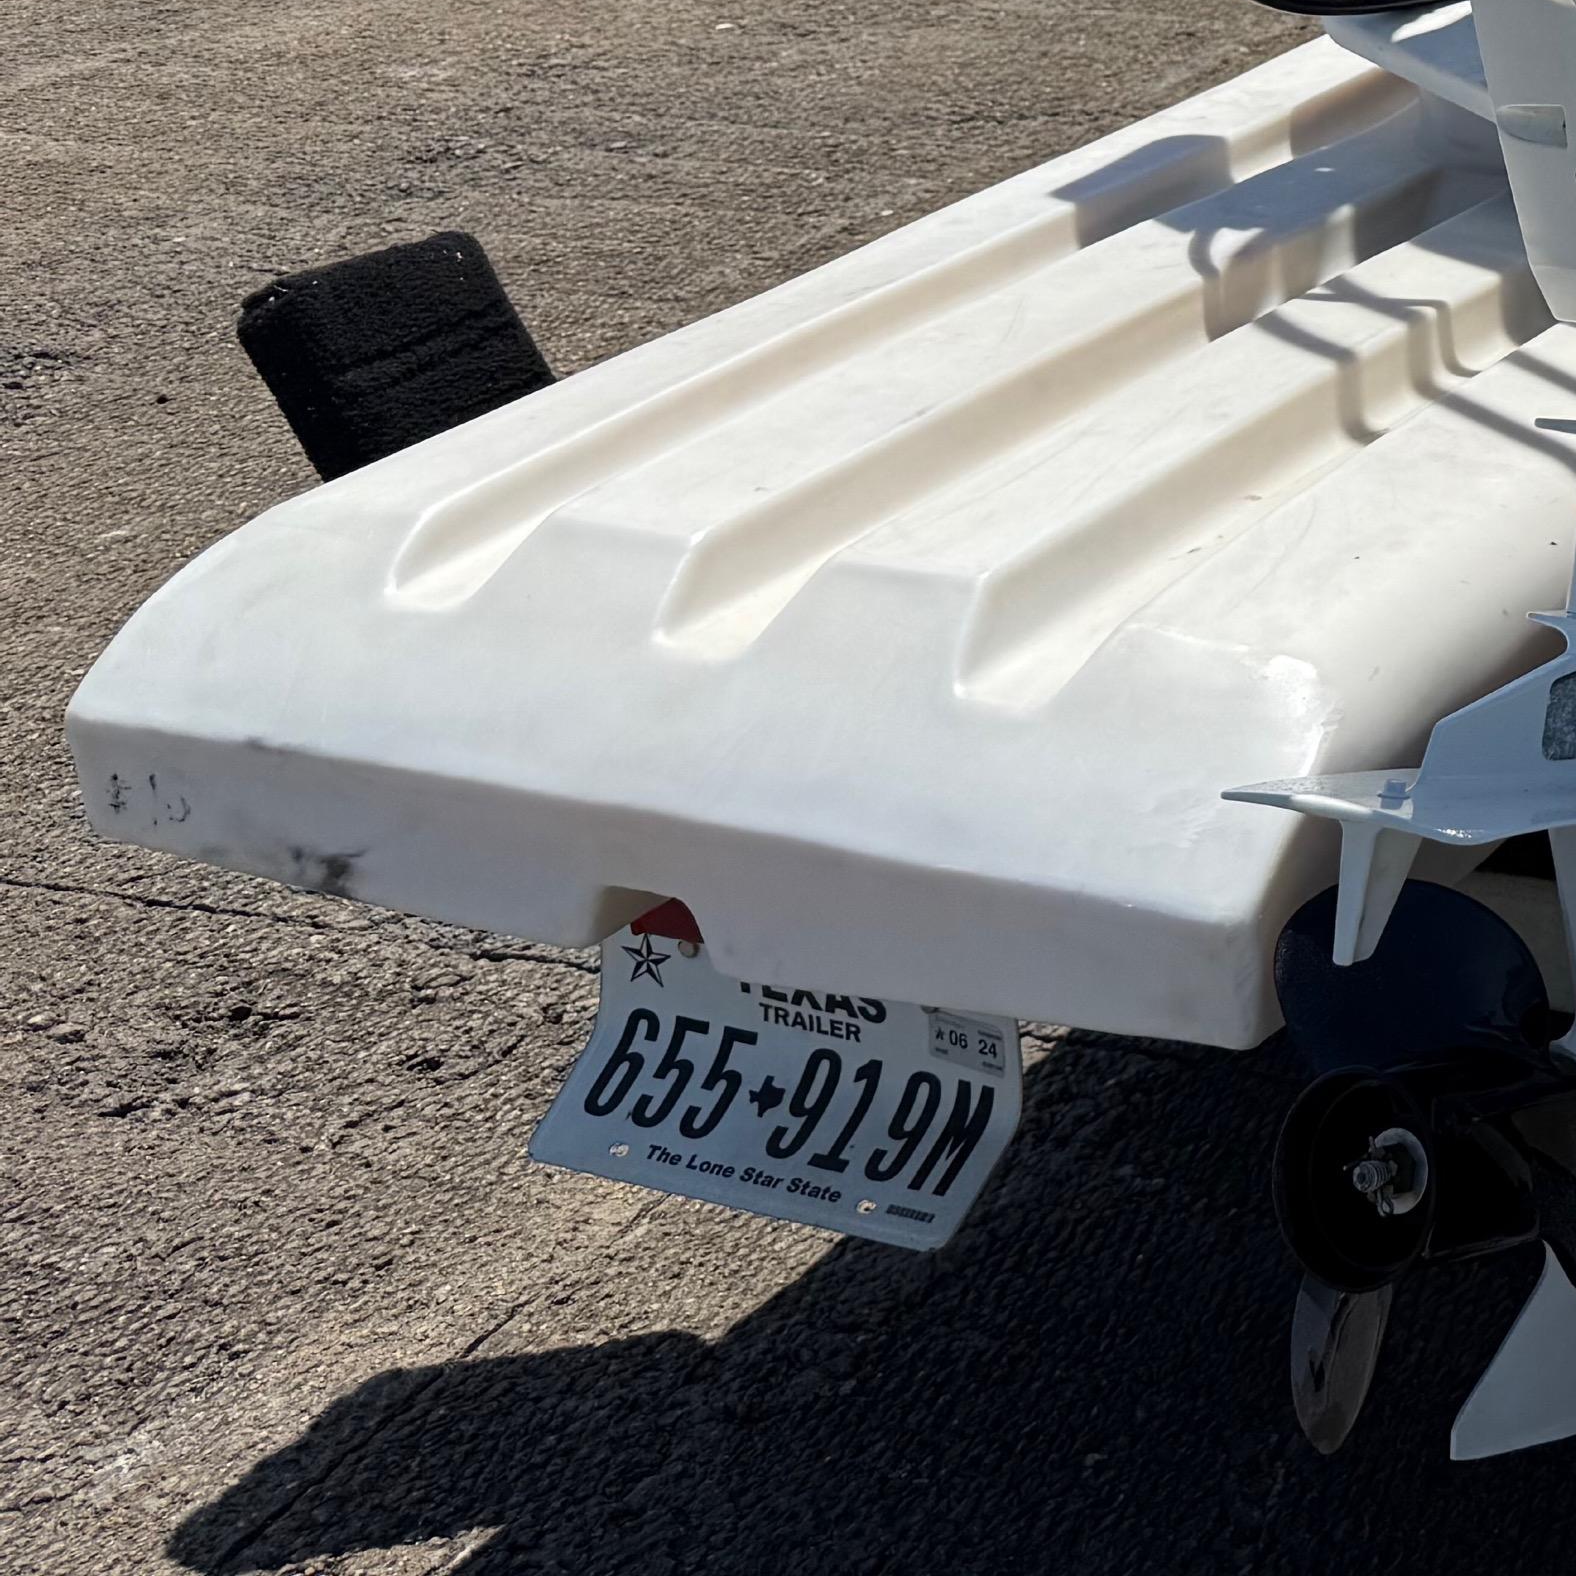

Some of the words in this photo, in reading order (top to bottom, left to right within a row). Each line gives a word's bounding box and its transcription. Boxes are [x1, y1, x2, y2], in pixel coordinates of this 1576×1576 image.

[758, 1001, 862, 1043] TRAILER
[949, 1029, 968, 1050] 06
[978, 1039, 997, 1060] 24
[646, 1144, 682, 1166] The
[686, 1154, 736, 1178] Lone
[739, 1167, 784, 1189] Star
[787, 1177, 842, 1203] State
